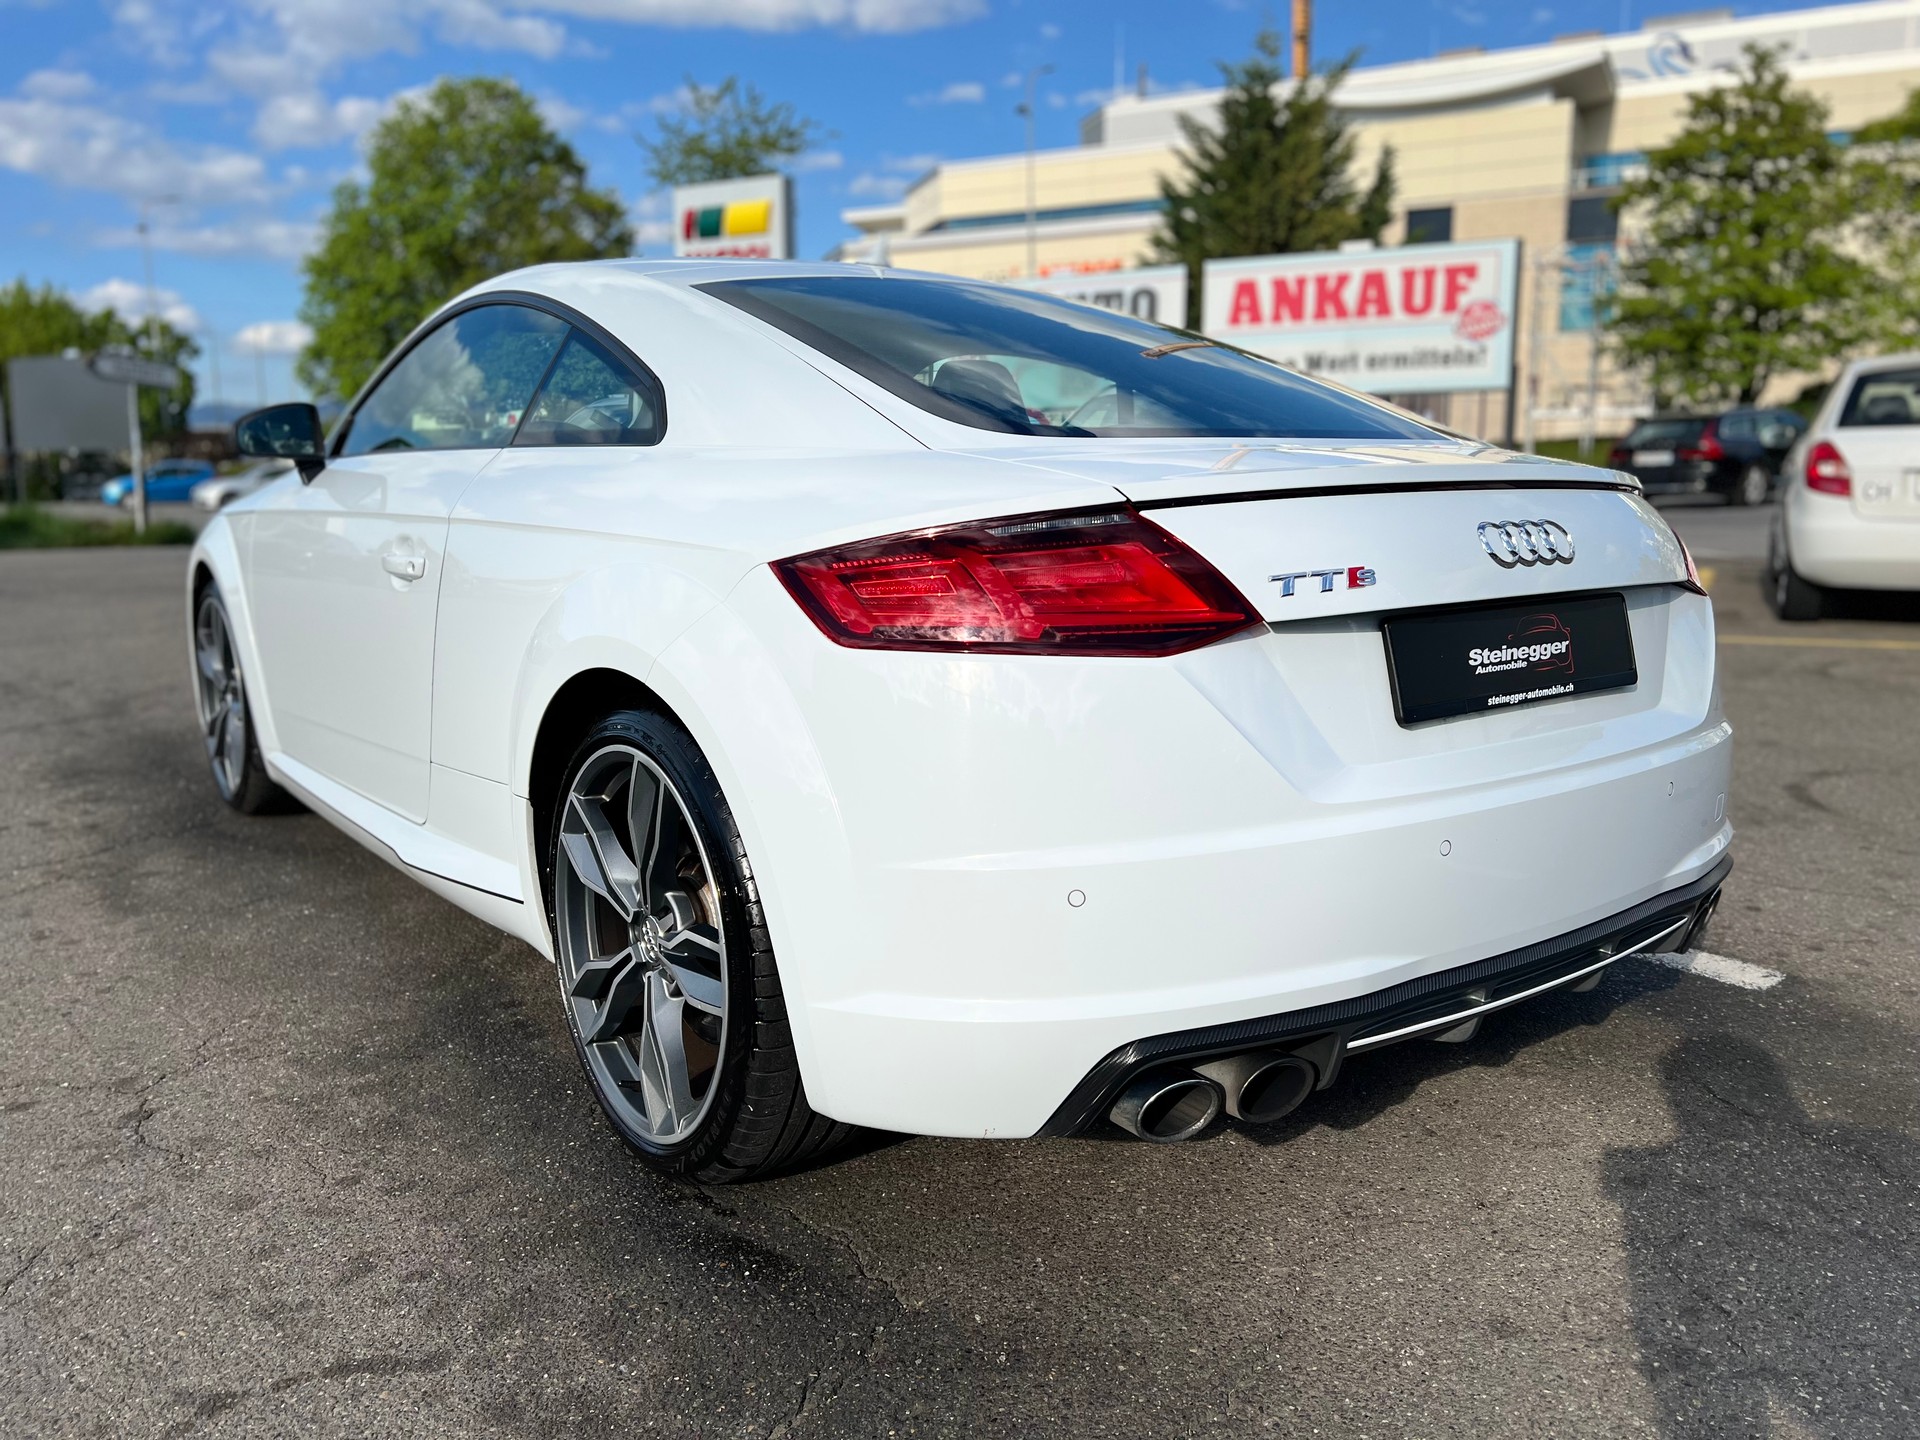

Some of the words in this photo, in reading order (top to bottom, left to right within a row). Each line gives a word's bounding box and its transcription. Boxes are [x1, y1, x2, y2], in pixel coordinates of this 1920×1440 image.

[1229, 263, 1478, 325] ANKAUF
[1268, 567, 1376, 597] TTS
[1468, 640, 1570, 666] Steinegger
[1475, 660, 1528, 675] Automobile
[1487, 683, 1574, 706] steinegger-automobile.ch
